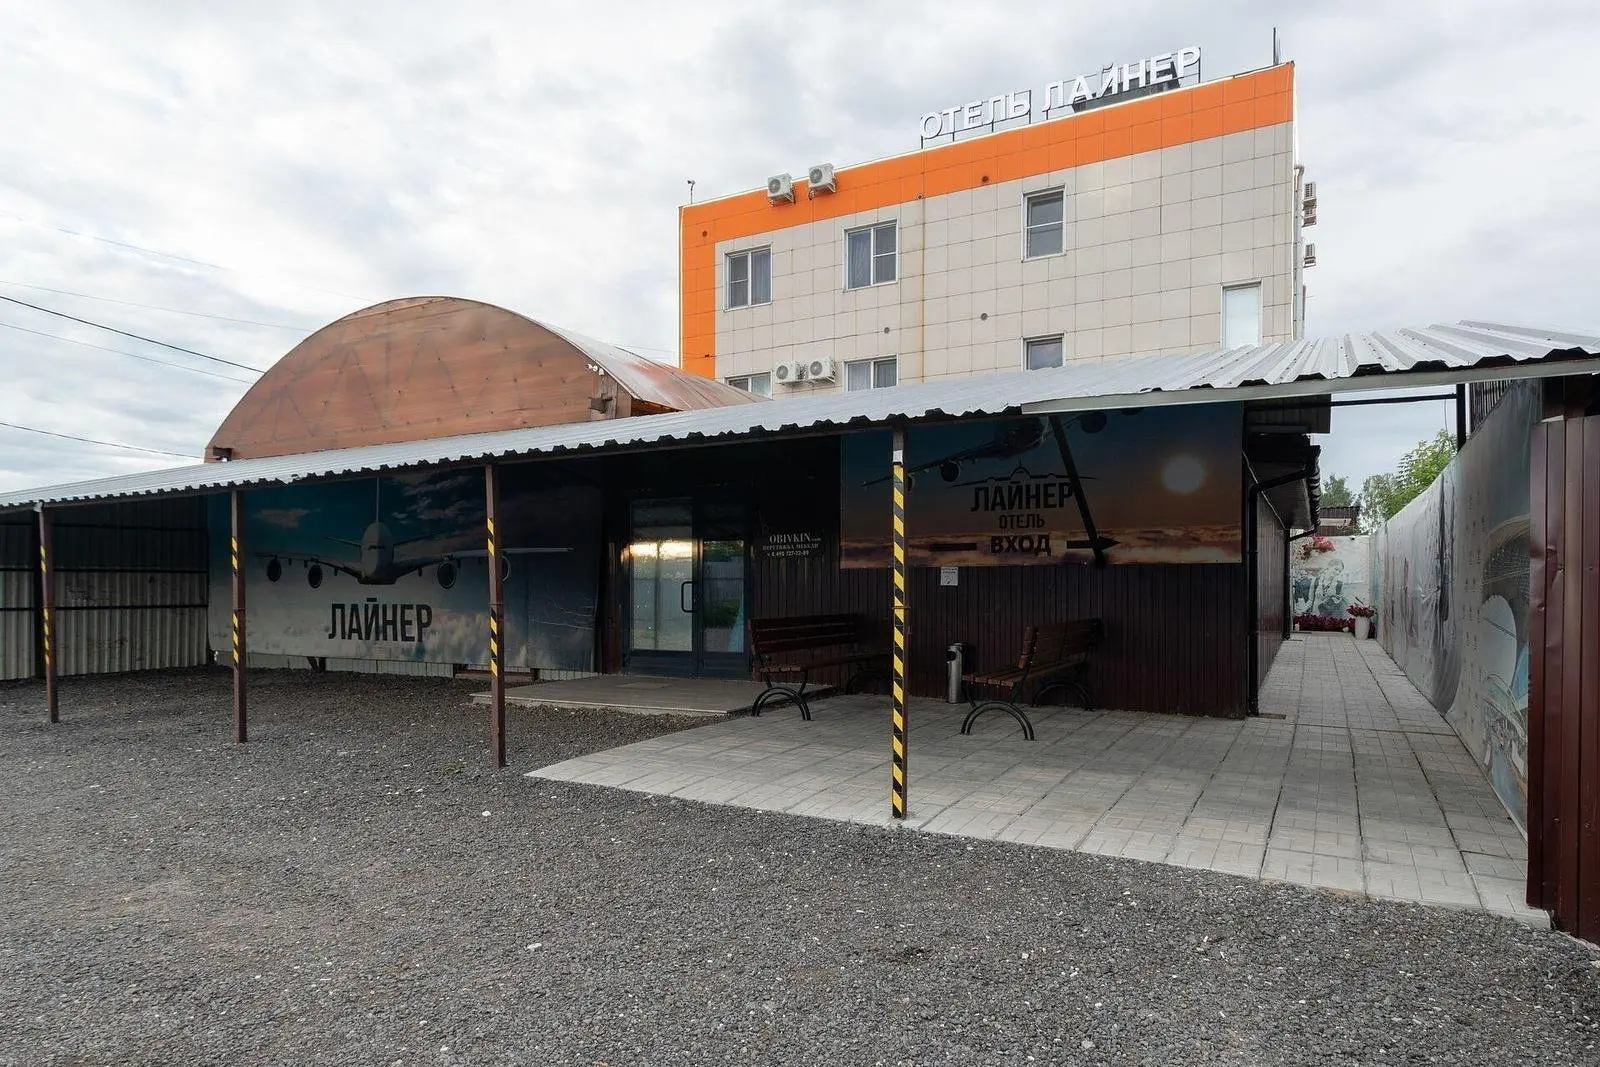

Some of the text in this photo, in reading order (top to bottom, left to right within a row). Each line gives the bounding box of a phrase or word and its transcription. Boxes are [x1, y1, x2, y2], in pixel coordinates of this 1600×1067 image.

[919, 47, 1201, 140] ОТЕЛЬ ЛАЙНЕР
[970, 481, 1073, 511] ЛАЙНЕР
[999, 514, 1045, 529] ОТЕЛЬ
[991, 533, 1051, 557] ВХОД
[328, 597, 433, 643] ЛАЙНЕР
